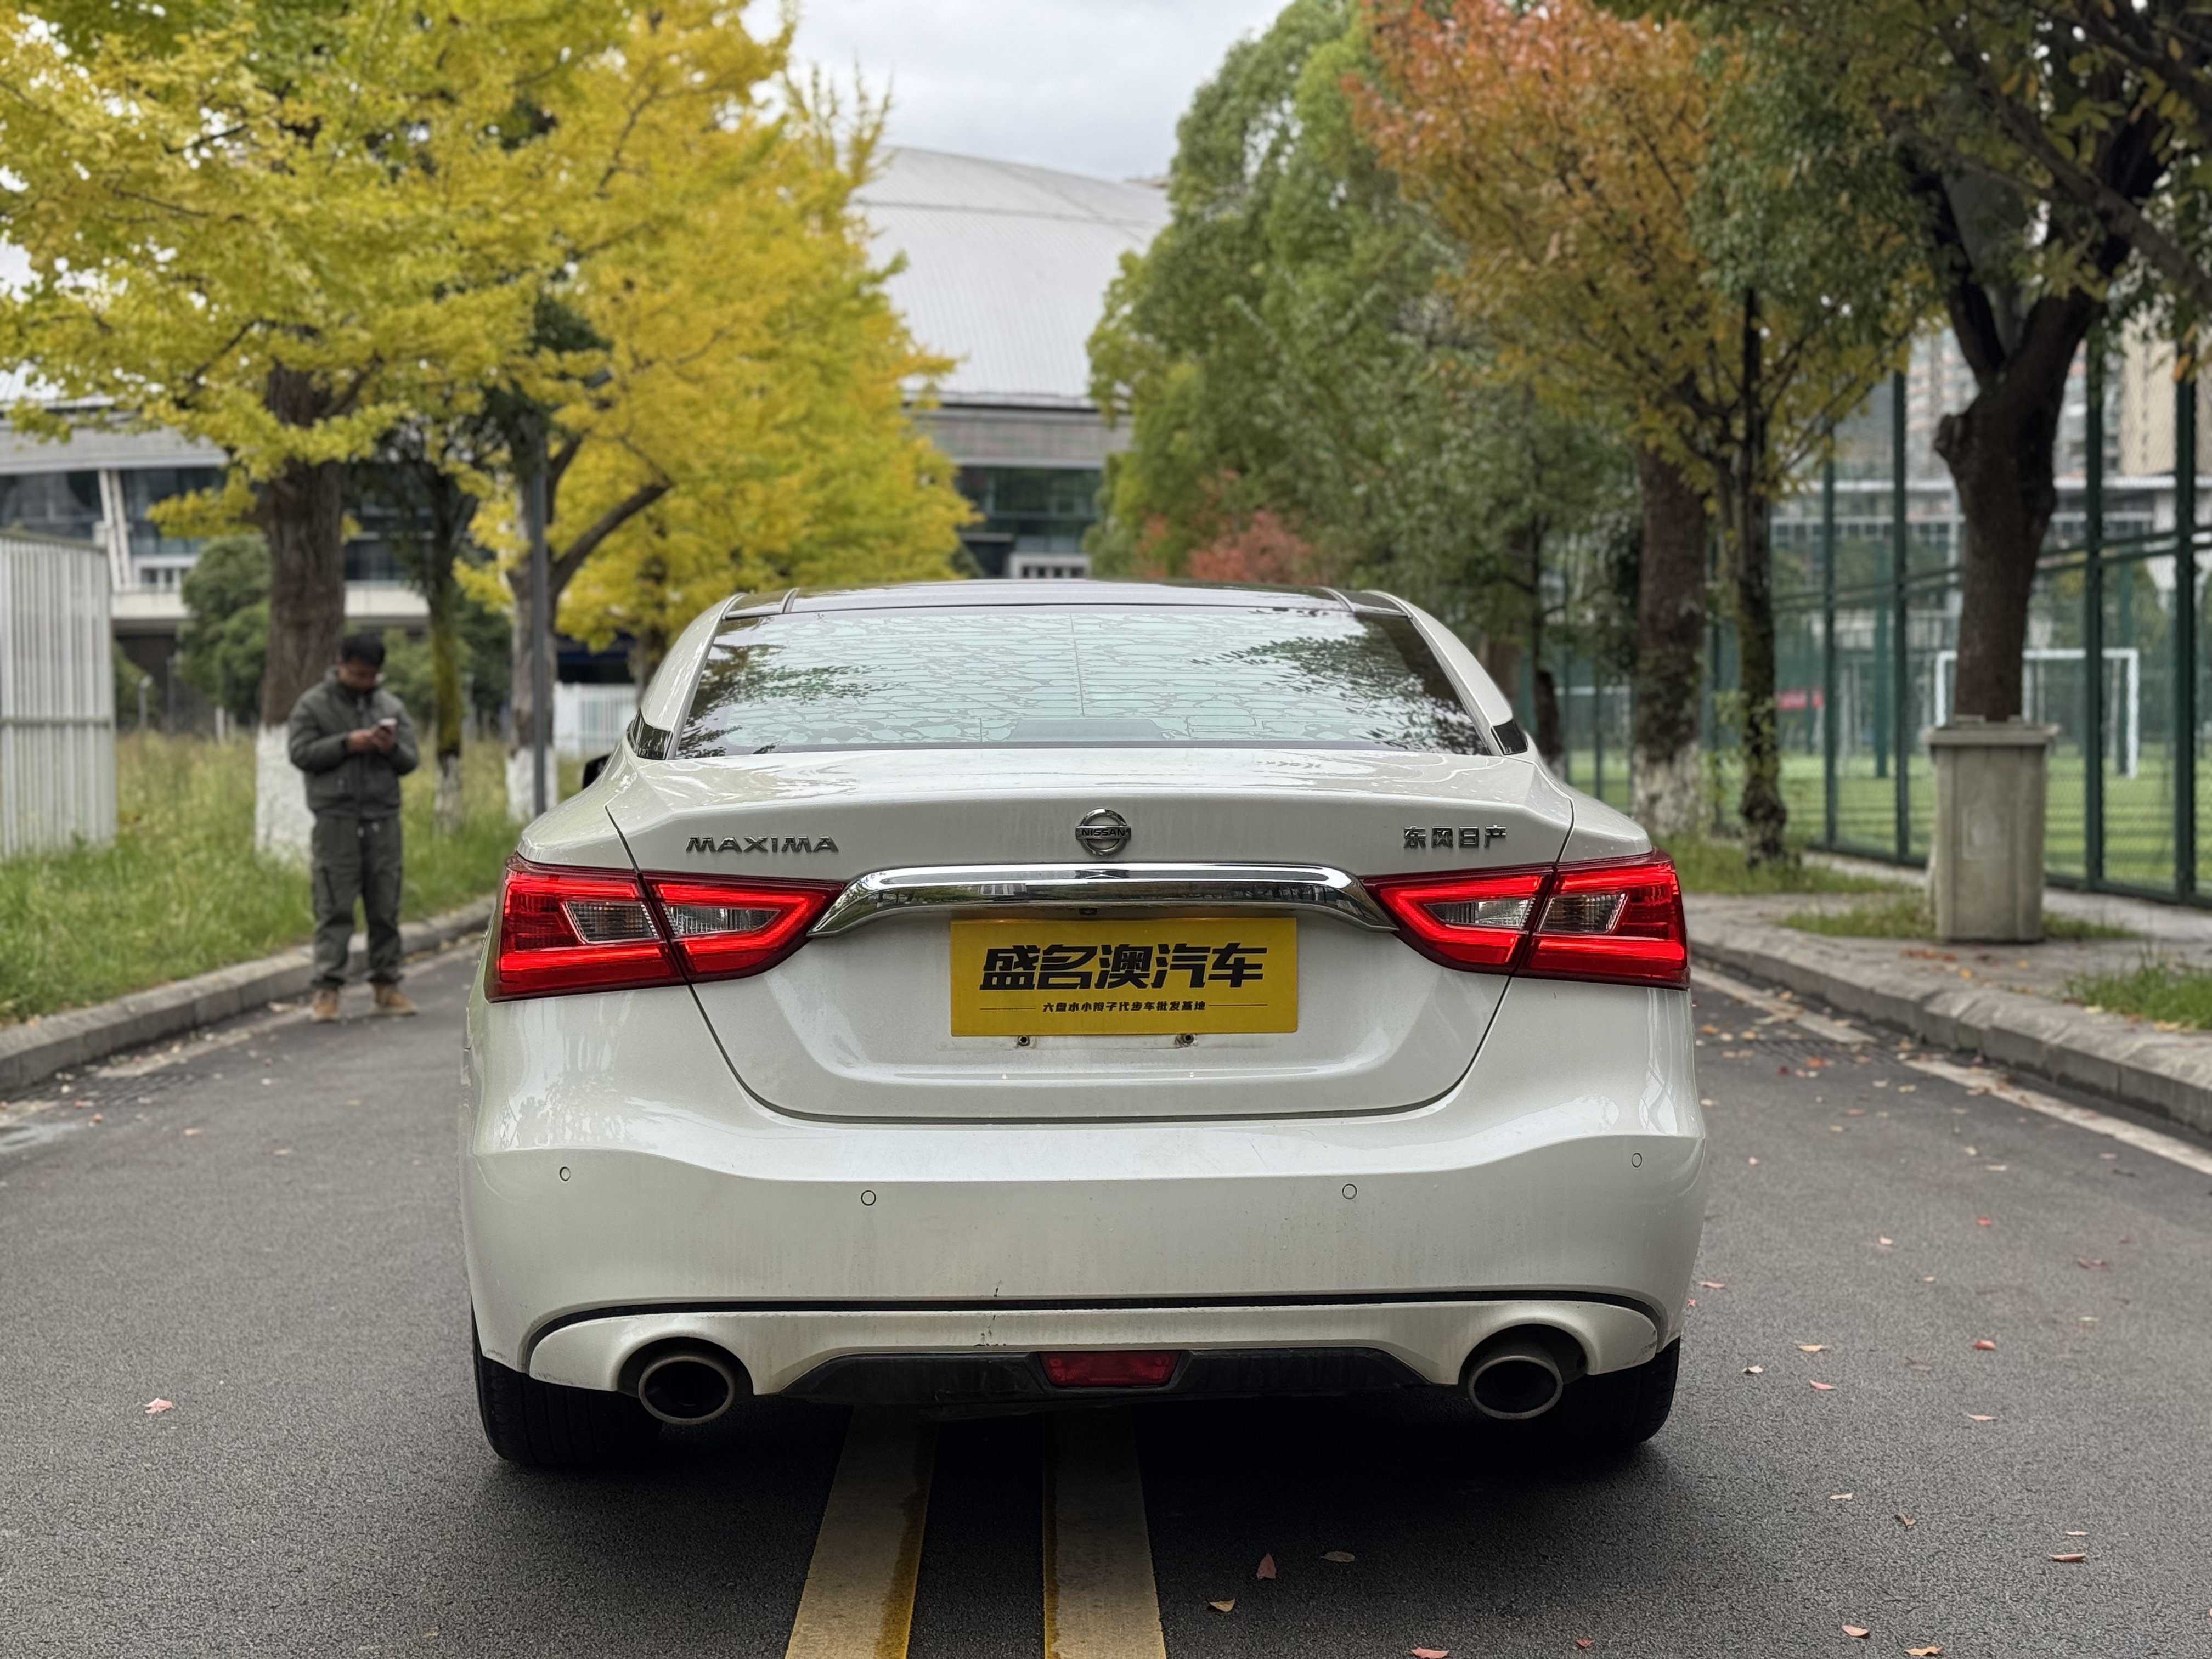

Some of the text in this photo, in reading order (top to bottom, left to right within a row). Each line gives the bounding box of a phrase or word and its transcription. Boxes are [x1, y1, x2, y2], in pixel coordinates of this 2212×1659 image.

[1081, 828, 1126, 837] NISSAN
[1403, 825, 1508, 849] 东风日产
[686, 835, 839, 853] MAXIMA
[979, 943, 1267, 991] 盛名澳汽车
